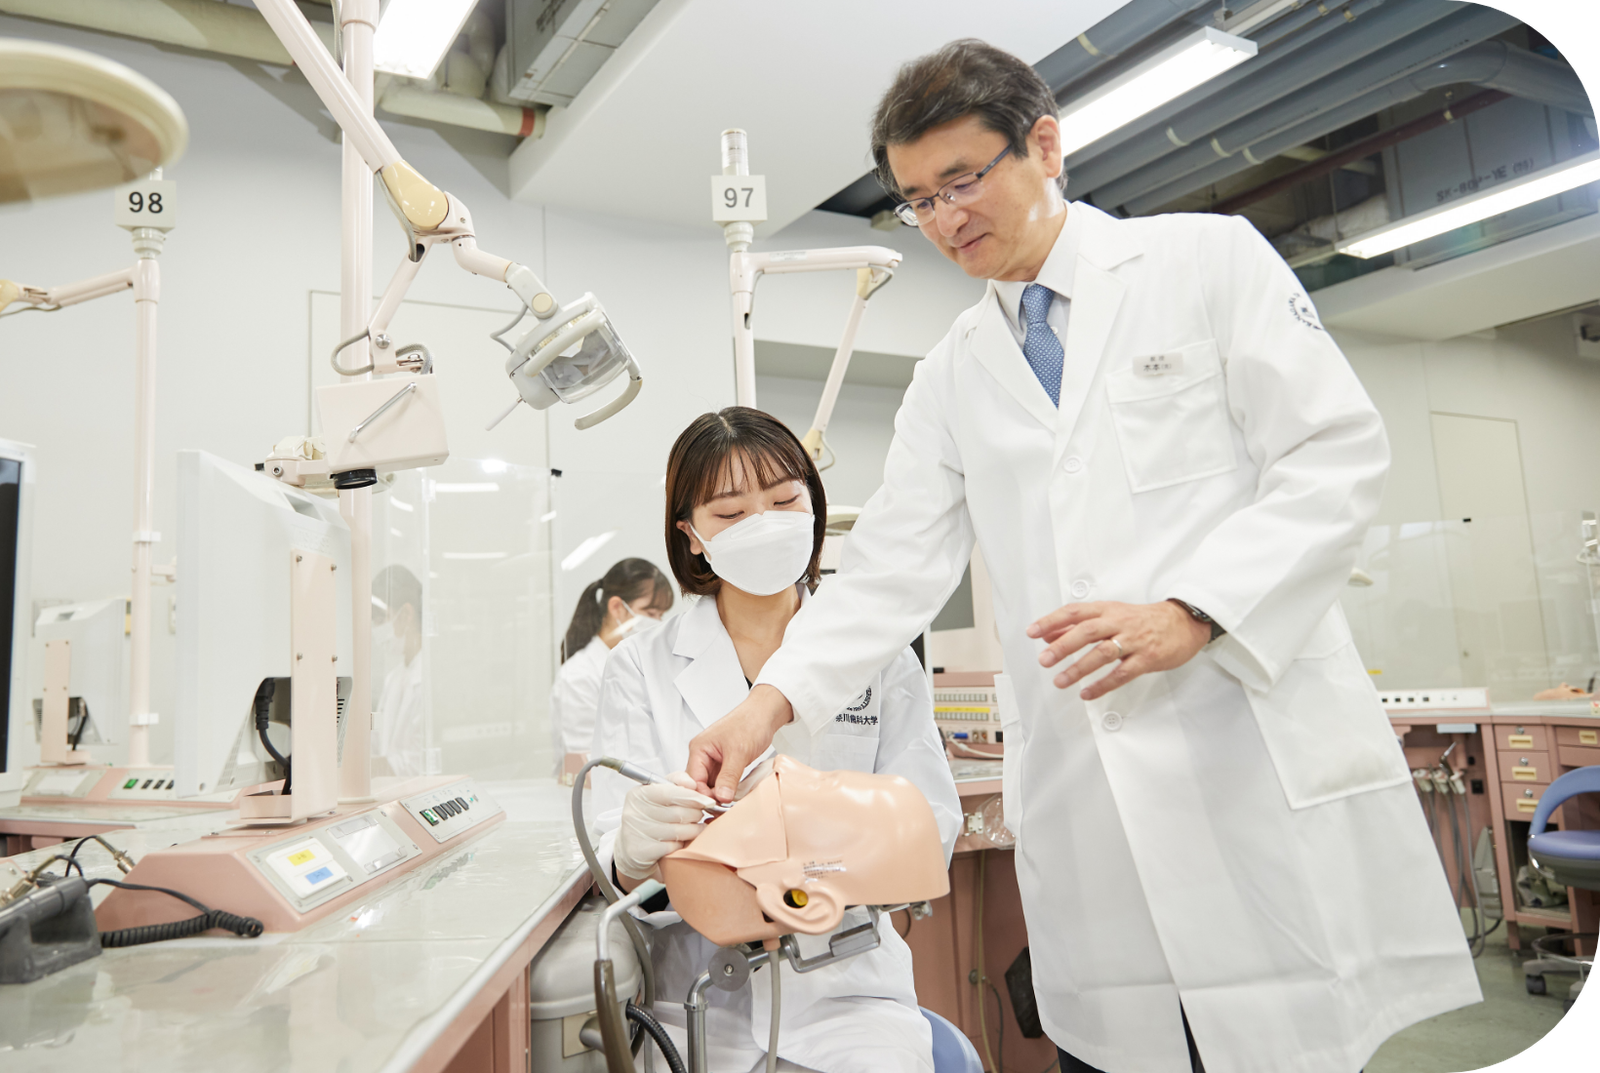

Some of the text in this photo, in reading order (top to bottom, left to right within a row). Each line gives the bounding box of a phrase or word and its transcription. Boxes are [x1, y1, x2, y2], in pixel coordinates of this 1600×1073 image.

[129, 191, 163, 213] 98
[724, 187, 754, 208] 97
[835, 713, 879, 726] 奈川歯科大学
